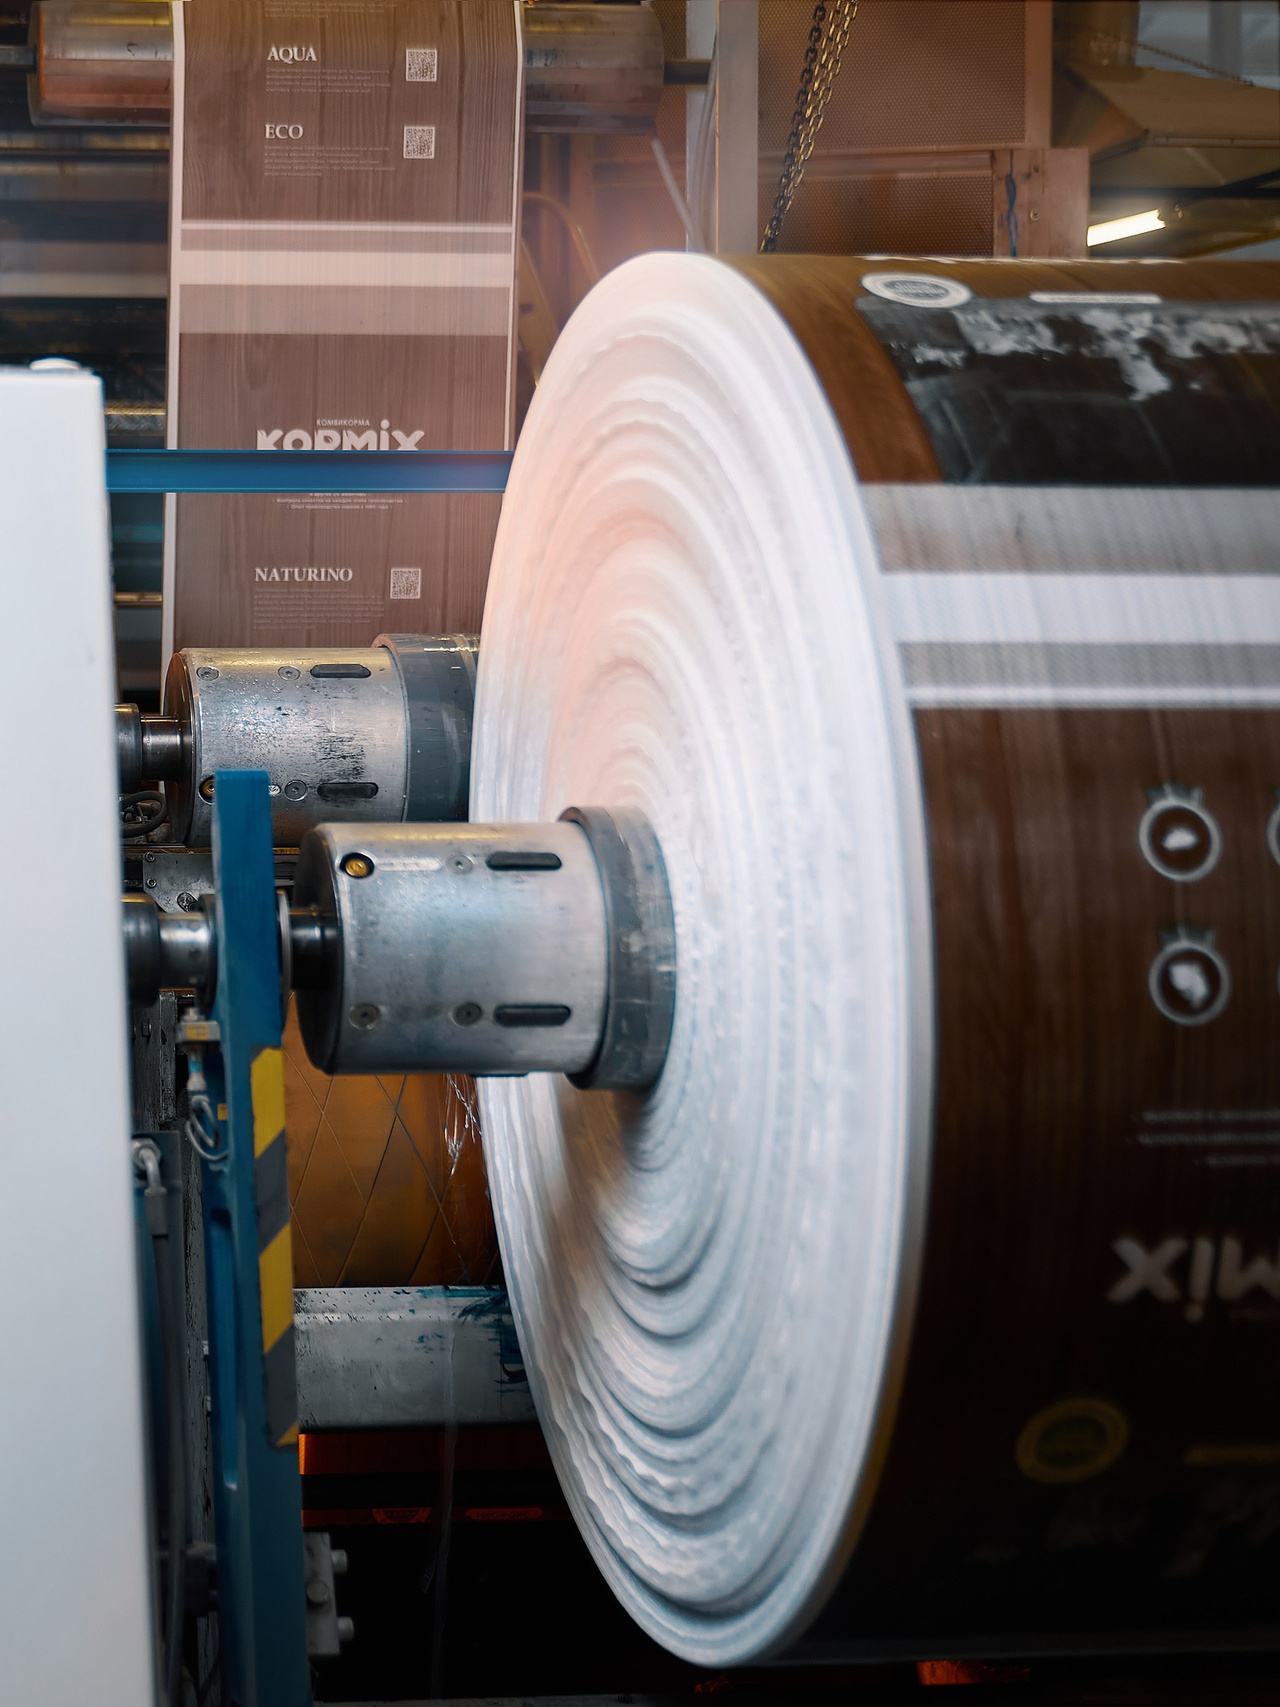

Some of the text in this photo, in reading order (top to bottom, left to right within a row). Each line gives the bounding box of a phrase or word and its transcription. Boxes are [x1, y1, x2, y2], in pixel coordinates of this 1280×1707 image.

[267, 46, 317, 64] AQUA
[265, 123, 304, 139] ECO
[316, 419, 370, 427] КОМБИКОРМА
[254, 567, 353, 583] NATURINO
